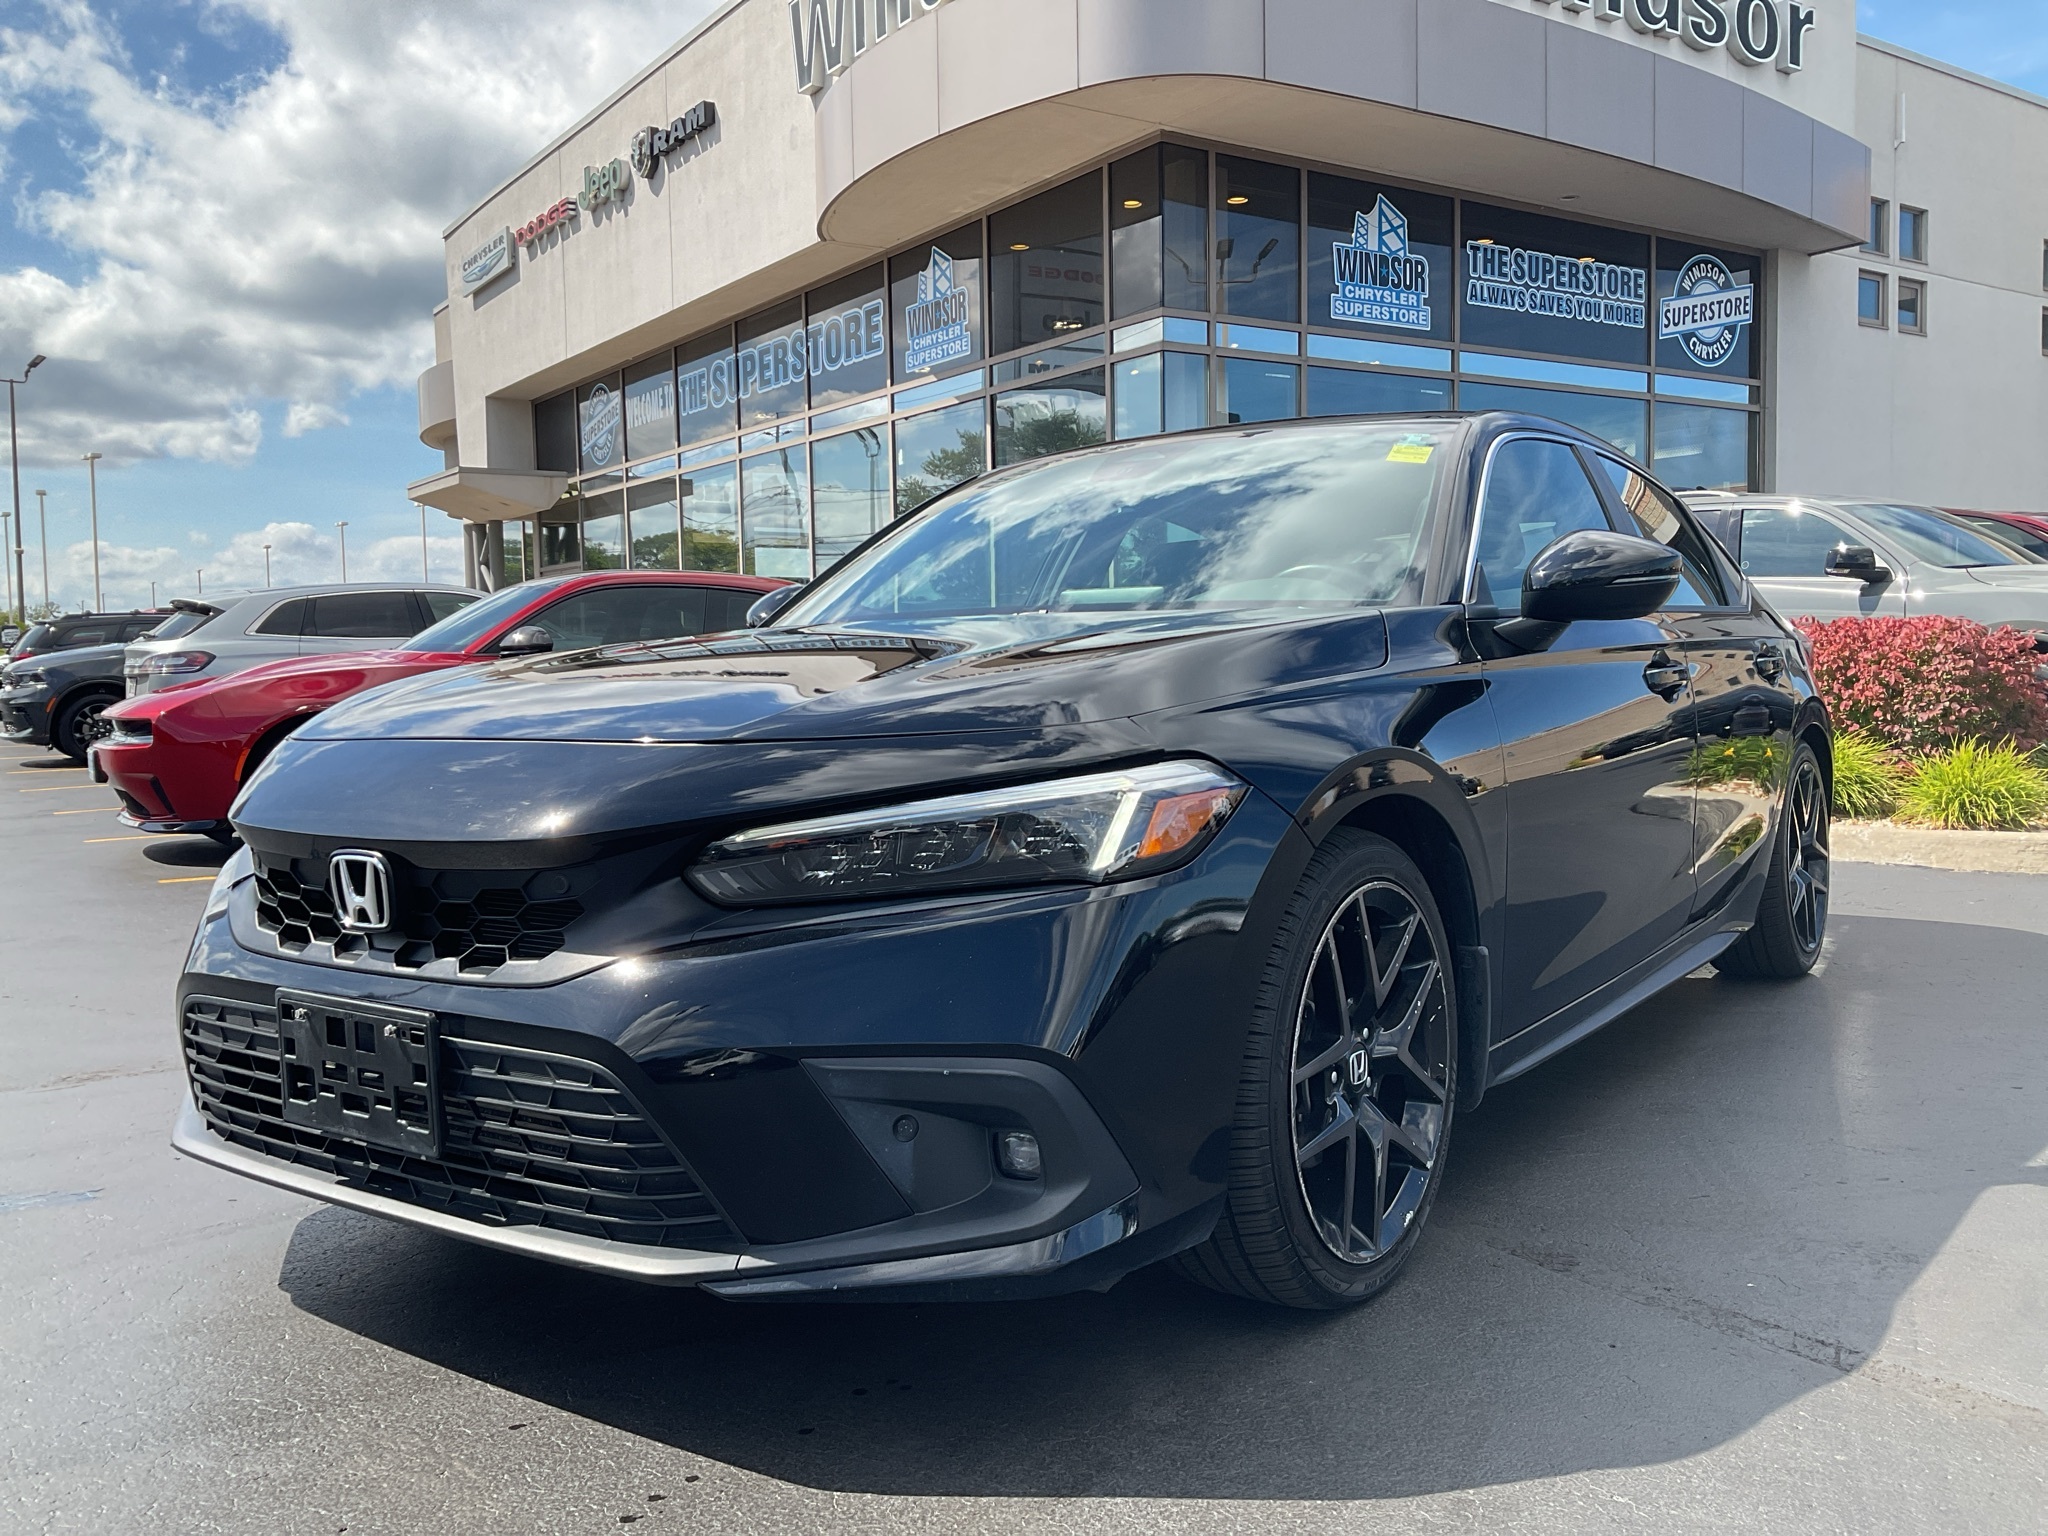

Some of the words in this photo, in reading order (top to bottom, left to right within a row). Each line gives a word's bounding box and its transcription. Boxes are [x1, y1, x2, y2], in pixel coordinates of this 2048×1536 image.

[653, 100, 712, 156] RAM
[578, 158, 627, 211] Jeep
[515, 197, 572, 247] DODGE
[462, 234, 505, 272] CHRYSLER
[1336, 247, 1427, 293] WINDSOR
[1469, 243, 1510, 281] THE
[1511, 250, 1646, 300] SUPERSTORE
[1344, 285, 1418, 306] CHRYSLER
[1682, 263, 1726, 291] WINDSOR
[908, 290, 967, 339] WINDSOR
[1335, 301, 1427, 325] SUPERSTORE
[1469, 282, 1527, 309] ALWAYS
[1528, 291, 1574, 318] SAVES
[1574, 298, 1602, 321] YOU
[1602, 303, 1644, 326] MORE!
[1663, 295, 1750, 329] SUPERSTORE
[908, 338, 969, 368] SUPERSTORE
[913, 325, 961, 350] CHRYSLER
[1689, 329, 1733, 360] CHRYSLER
[625, 386, 664, 430] WELCOME
[664, 383, 675, 416] TO
[679, 370, 708, 415] THE
[711, 300, 883, 408] SUPERSTORE
[583, 401, 619, 447] SUPERSTORE
